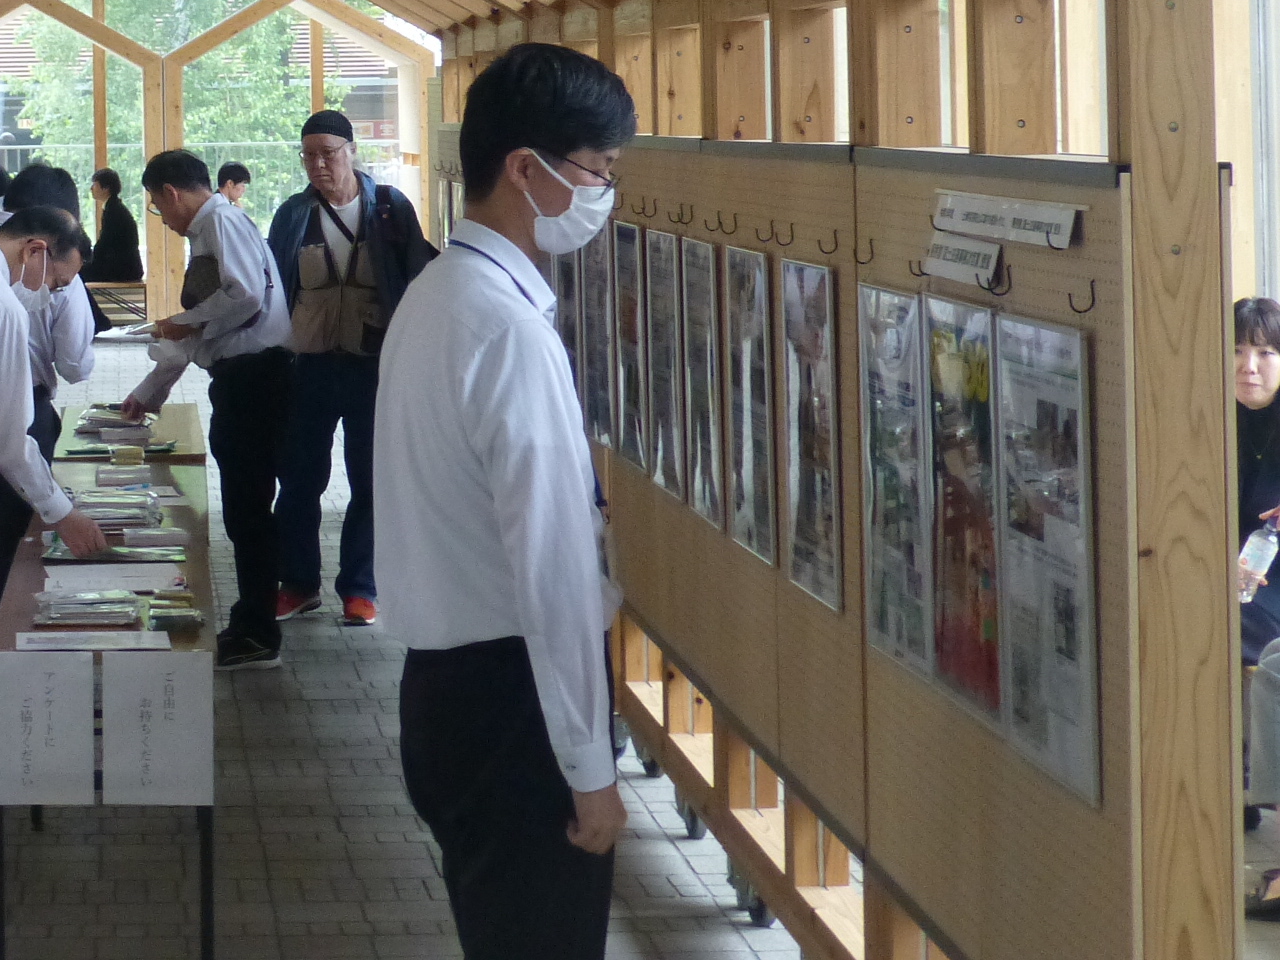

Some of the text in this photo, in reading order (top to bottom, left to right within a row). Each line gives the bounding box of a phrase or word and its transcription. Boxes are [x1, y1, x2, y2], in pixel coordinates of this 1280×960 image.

[44, 671, 55, 748] アンケートに
[163, 671, 176, 721] ご自由に
[21, 697, 33, 786] ご協力ください
[140, 698, 152, 786] お持ちください
